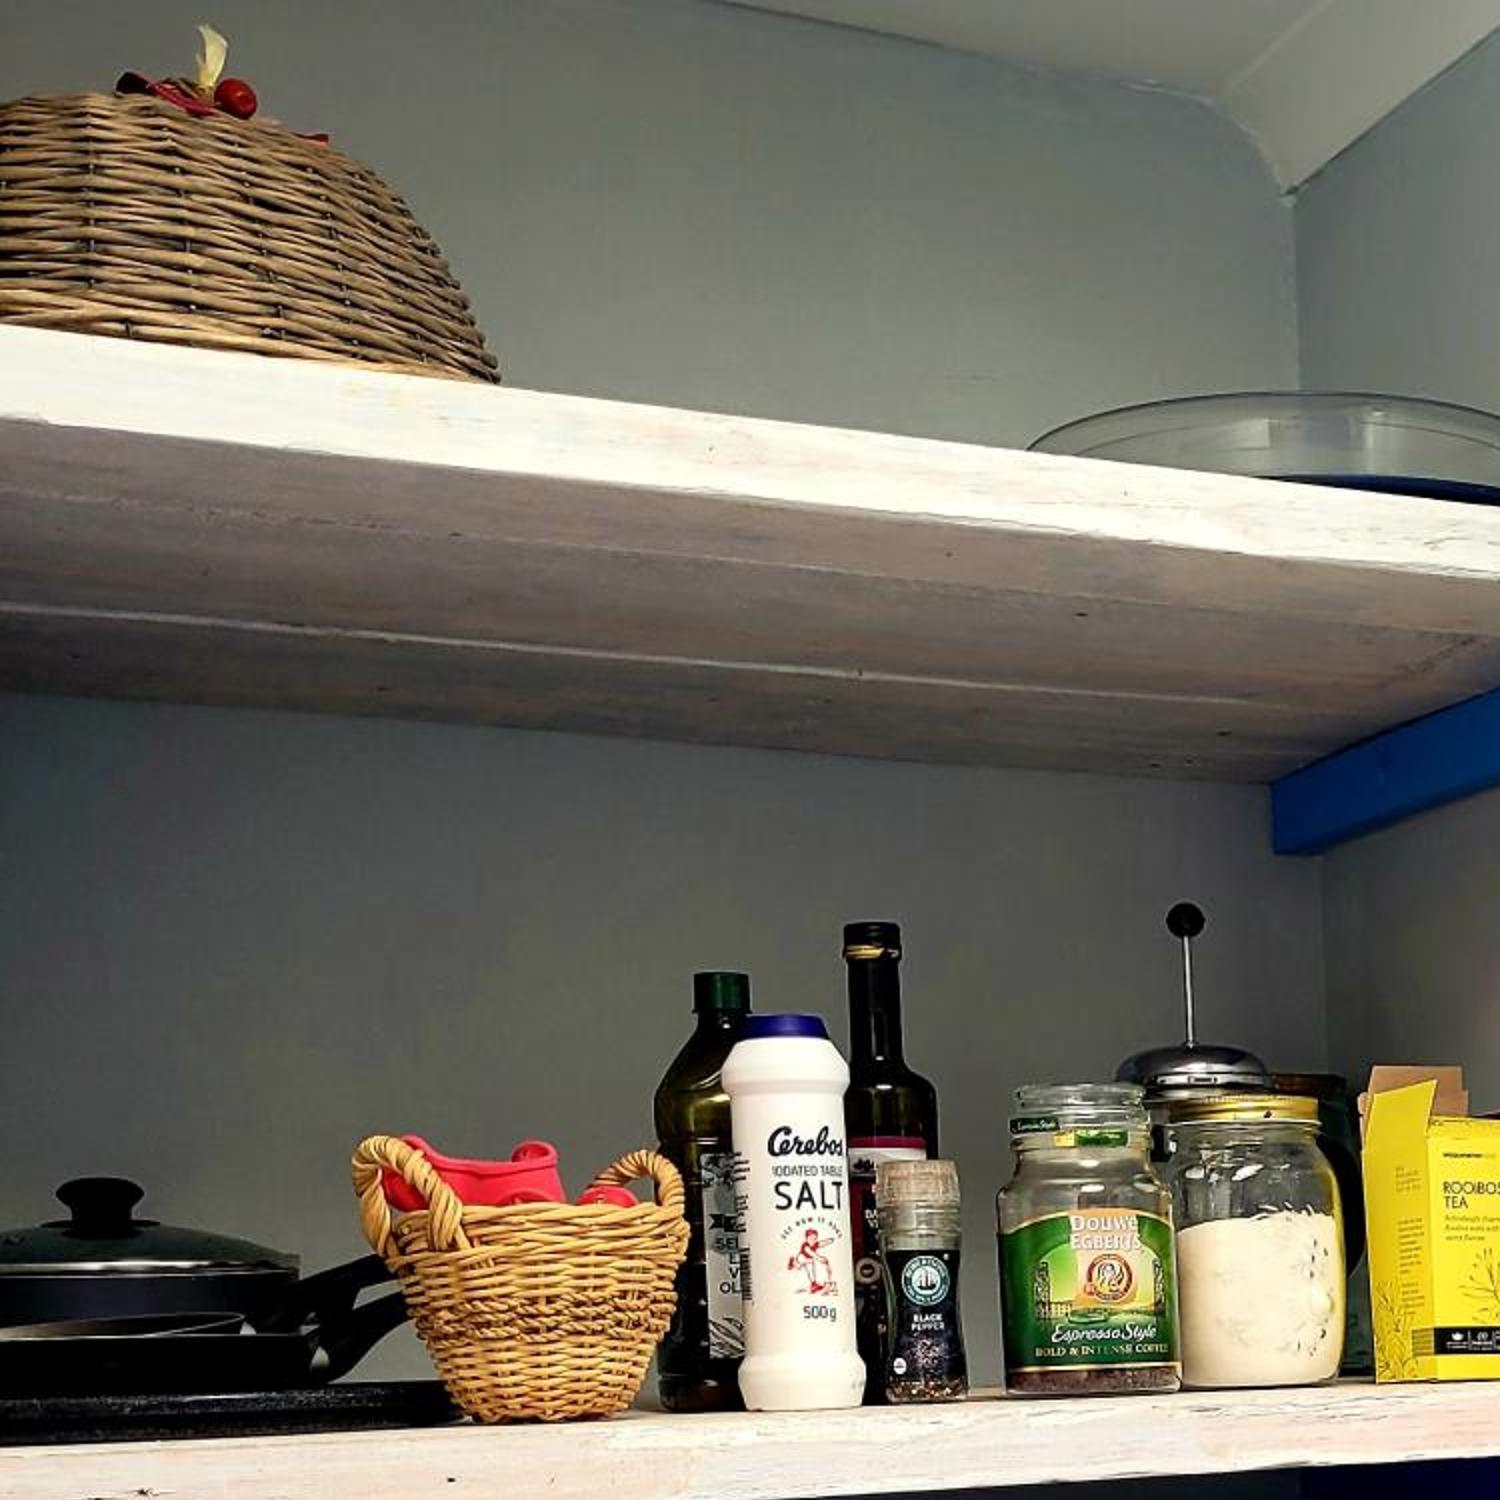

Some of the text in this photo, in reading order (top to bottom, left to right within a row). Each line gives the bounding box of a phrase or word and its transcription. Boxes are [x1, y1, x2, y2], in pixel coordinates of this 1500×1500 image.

[774, 1180, 843, 1211] SALT
[1443, 1195, 1469, 1209] TEA
[1070, 1216, 1138, 1231] DOUWE
[913, 1313, 943, 1323] BLACK
[1051, 1321, 1157, 1344] Espresso Style
[1035, 1347, 1065, 1358] BOLD
[1069, 1346, 1079, 1356] &
